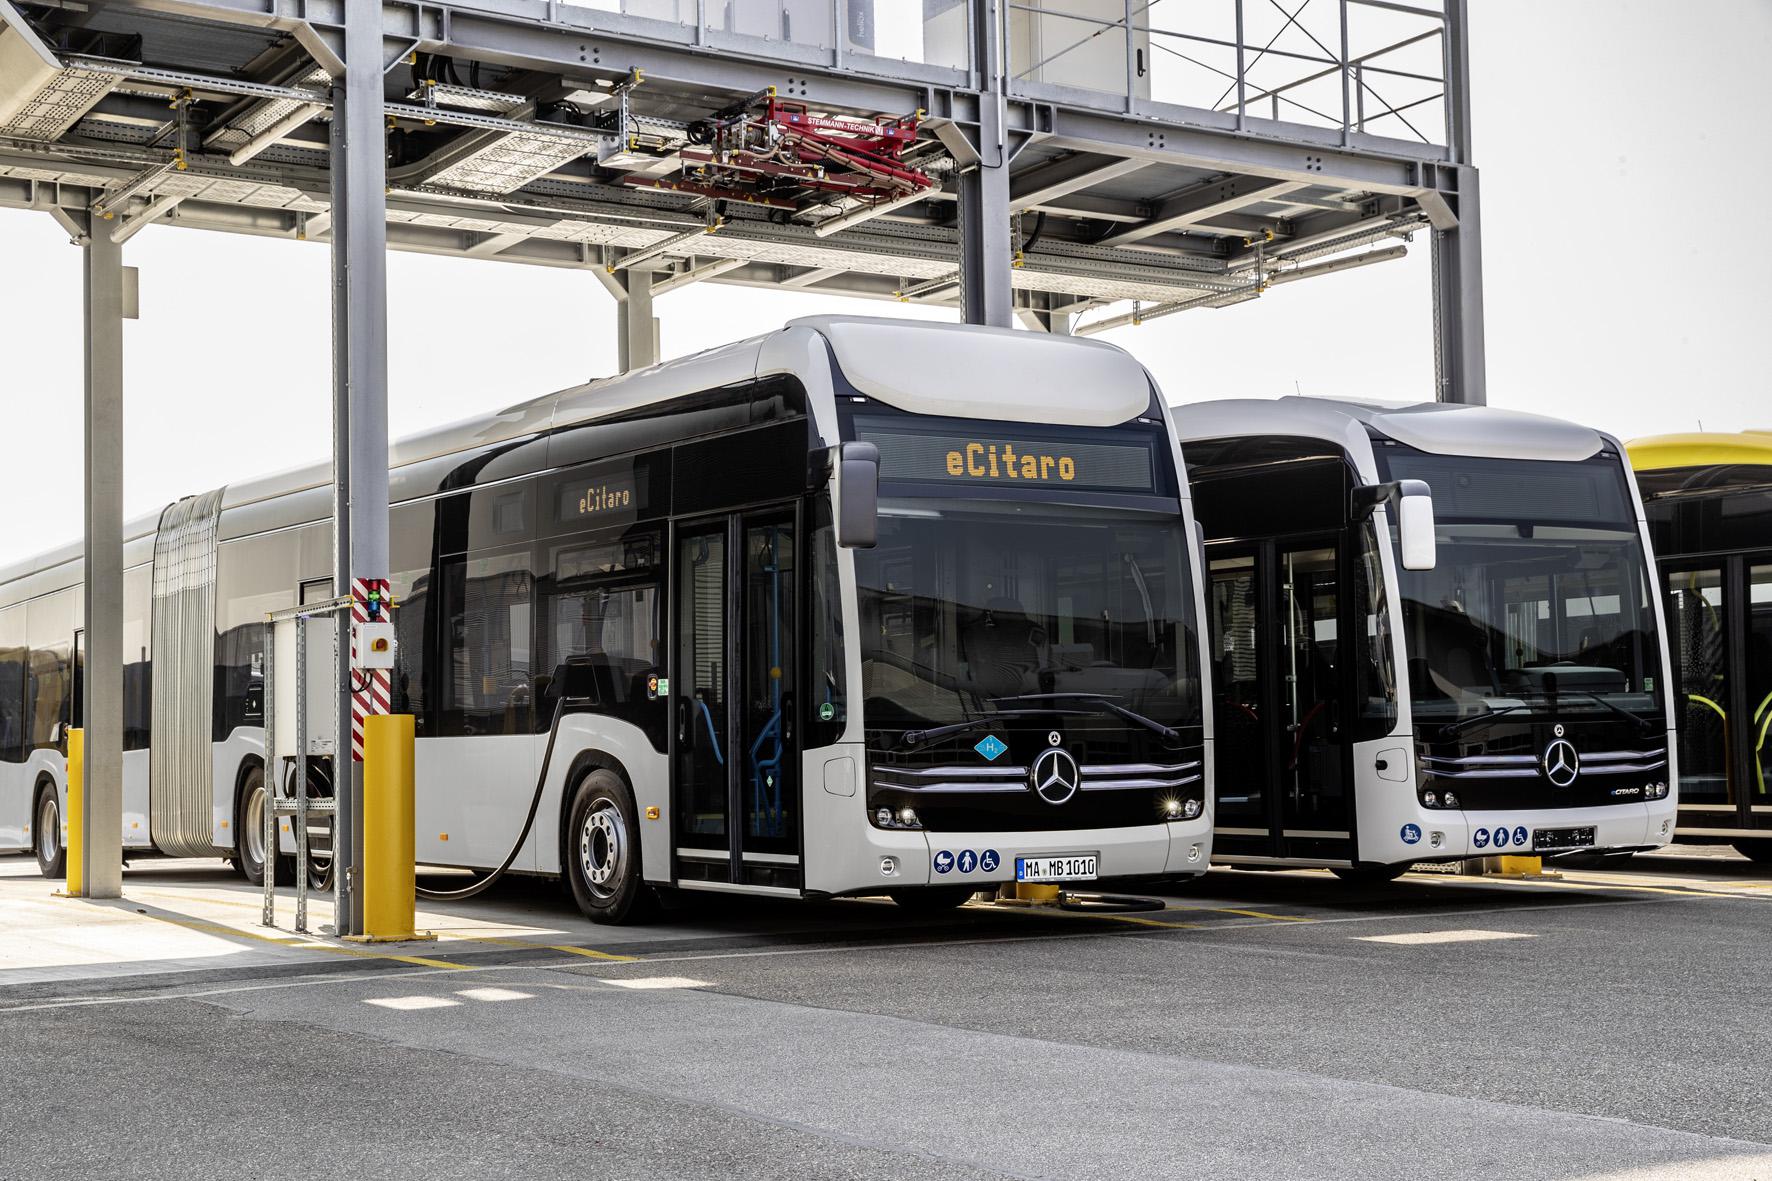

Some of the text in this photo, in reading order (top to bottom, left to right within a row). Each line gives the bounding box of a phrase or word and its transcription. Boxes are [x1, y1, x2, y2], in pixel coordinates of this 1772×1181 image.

[856, 11, 865, 38] heliox
[807, 117, 875, 133] STEMMANN-TECHNIK
[946, 443, 1075, 481] eCitaro
[578, 487, 630, 514] eCitaro
[1025, 858, 1095, 877] MA MB 1010
